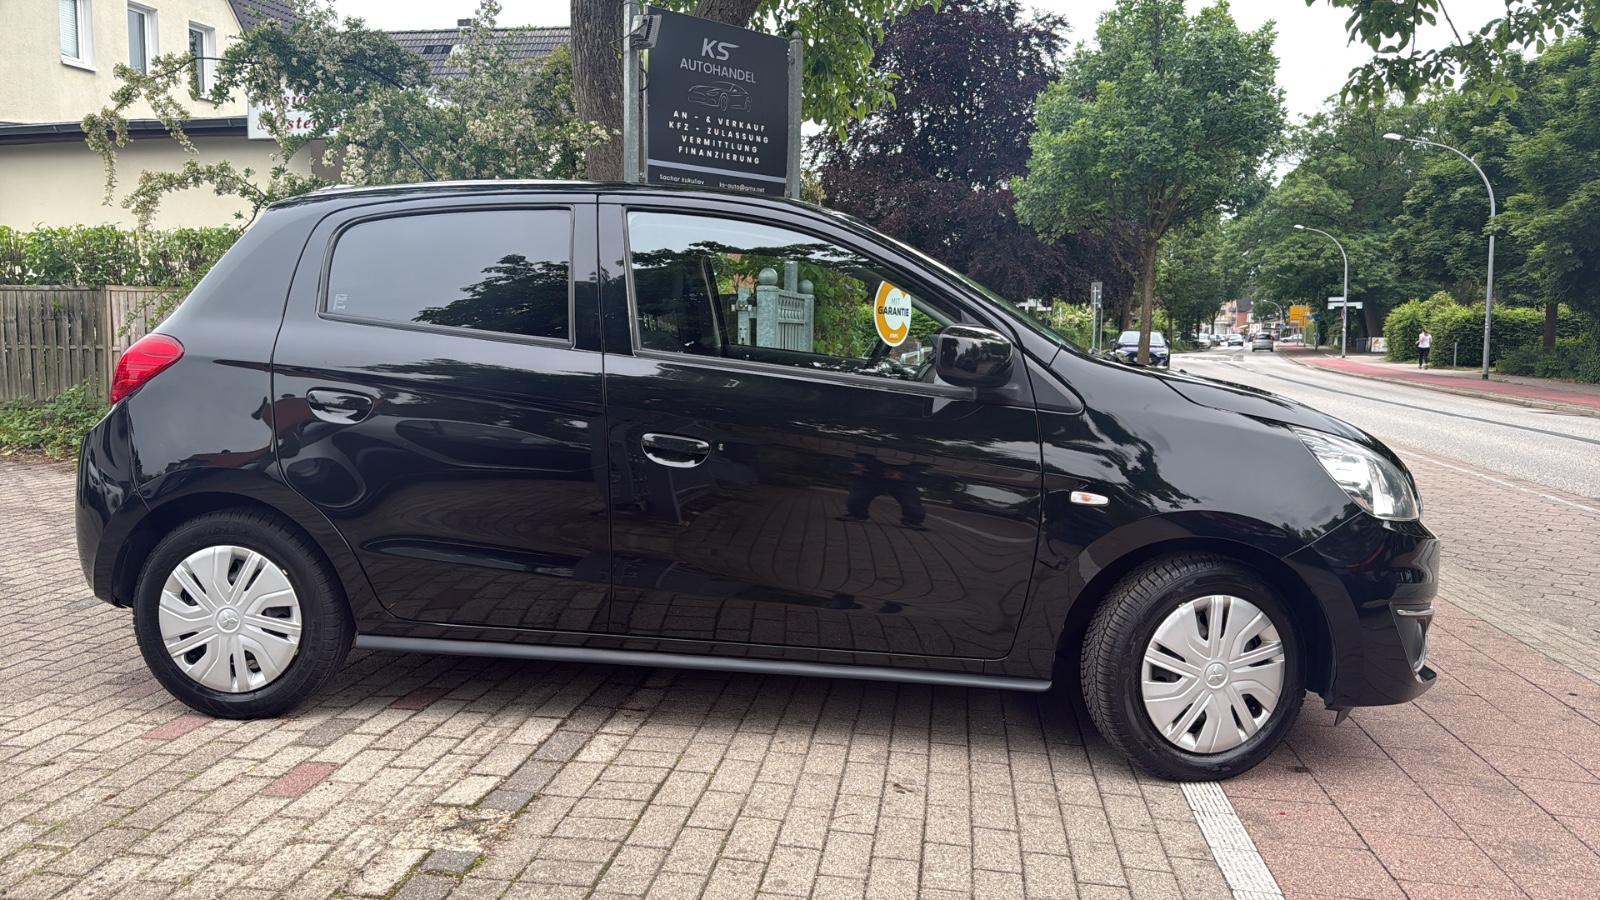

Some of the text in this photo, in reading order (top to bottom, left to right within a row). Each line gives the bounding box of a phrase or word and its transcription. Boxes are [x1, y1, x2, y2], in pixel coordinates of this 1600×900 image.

[701, 38, 741, 61] KS
[680, 57, 757, 84] AUTOHANDEL
[673, 110, 688, 119] AN
[718, 118, 765, 131] VERKAUF
[668, 121, 689, 131] KFZ
[706, 127, 769, 144] ZULASSUNG
[681, 135, 758, 153] VERMITTLUNG
[678, 146, 760, 165] FINANZIERUNG
[878, 306, 909, 316] GARANTIE
